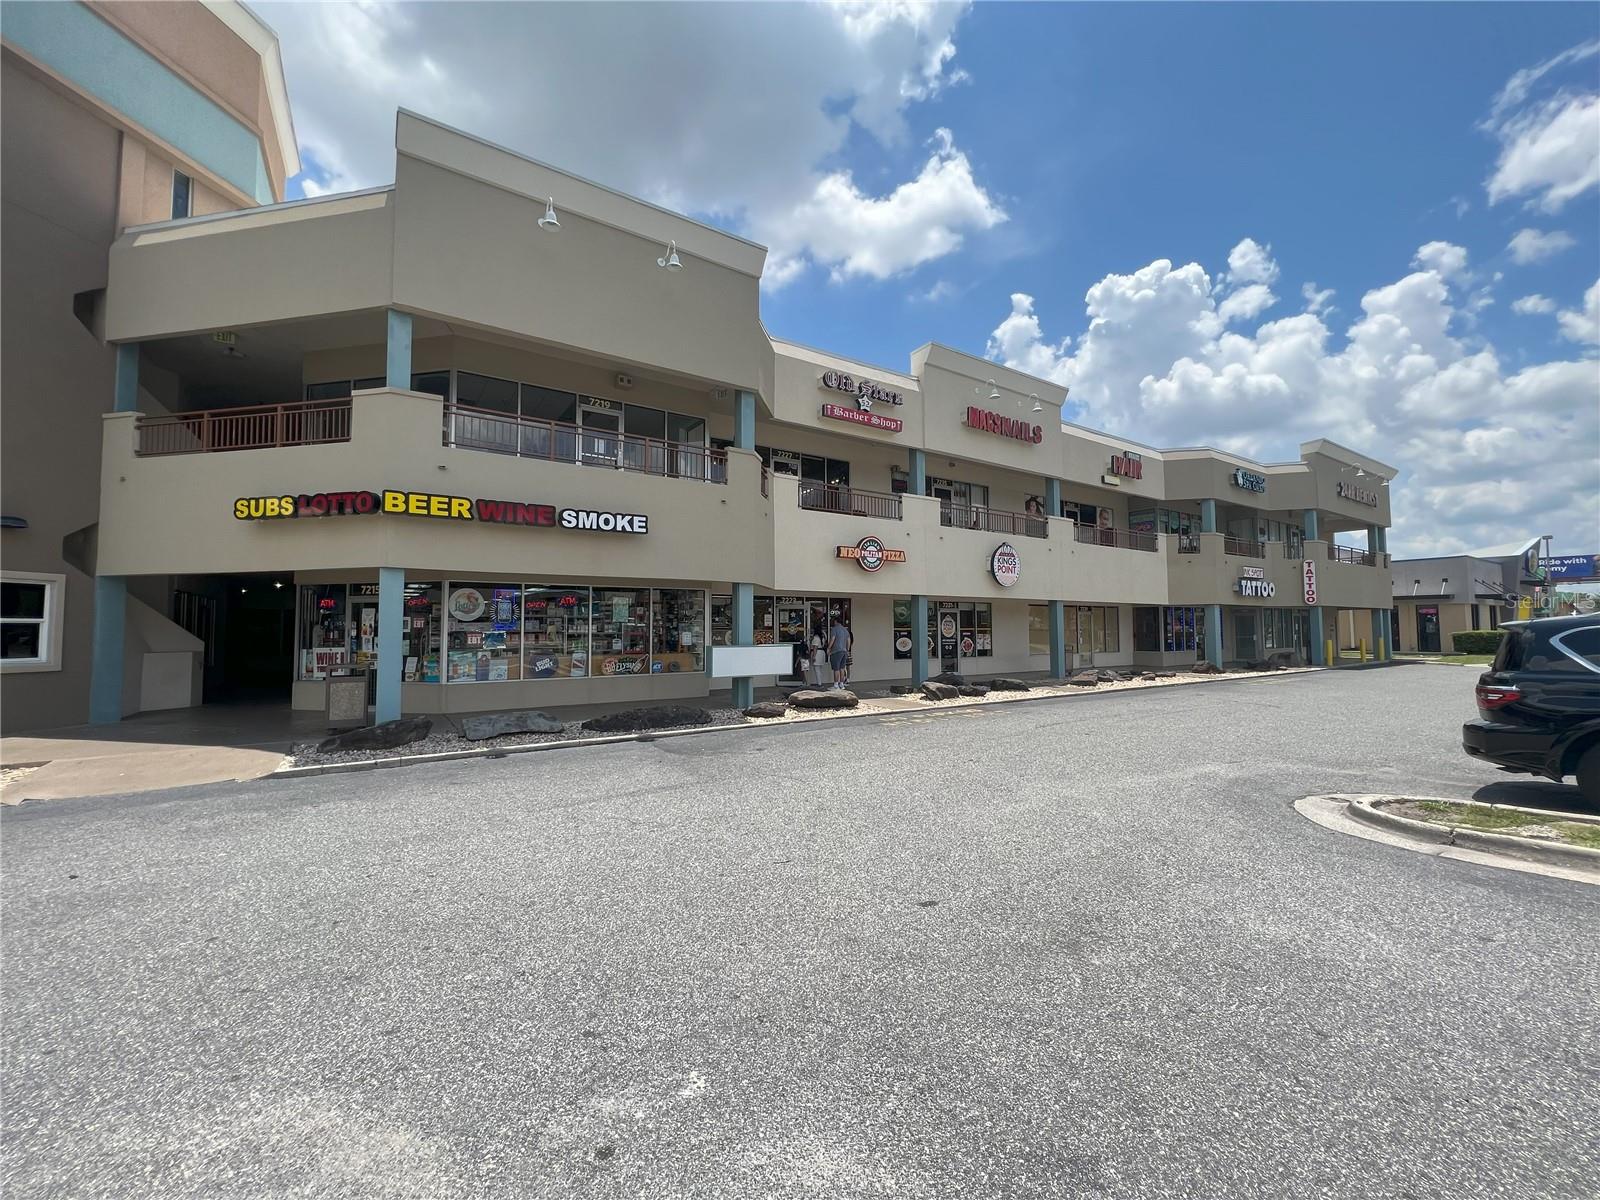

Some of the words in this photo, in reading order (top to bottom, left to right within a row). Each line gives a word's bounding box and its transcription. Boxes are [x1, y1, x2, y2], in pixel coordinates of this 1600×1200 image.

[590, 398, 611, 409] 7219
[833, 405, 870, 422] Barber
[870, 414, 897, 429] Shop
[235, 497, 294, 518] SUBS
[298, 492, 374, 514] LOTTO
[384, 491, 472, 518] BEER
[478, 501, 555, 525] WINE
[561, 509, 648, 533] SMOKE
[840, 547, 860, 558] NEO
[883, 550, 905, 561] PIZZA
[997, 557, 1017, 566] KINGS
[1563, 557, 1587, 565] with
[997, 564, 1017, 574] POINT
[1305, 561, 1316, 603] TATTOO
[1241, 580, 1276, 597] TATTOO
[320, 599, 335, 608] ATM
[408, 597, 428, 606] OPEN
[560, 595, 577, 606] ATM
[467, 636, 481, 645] EBT
[316, 652, 340, 665] WINE
